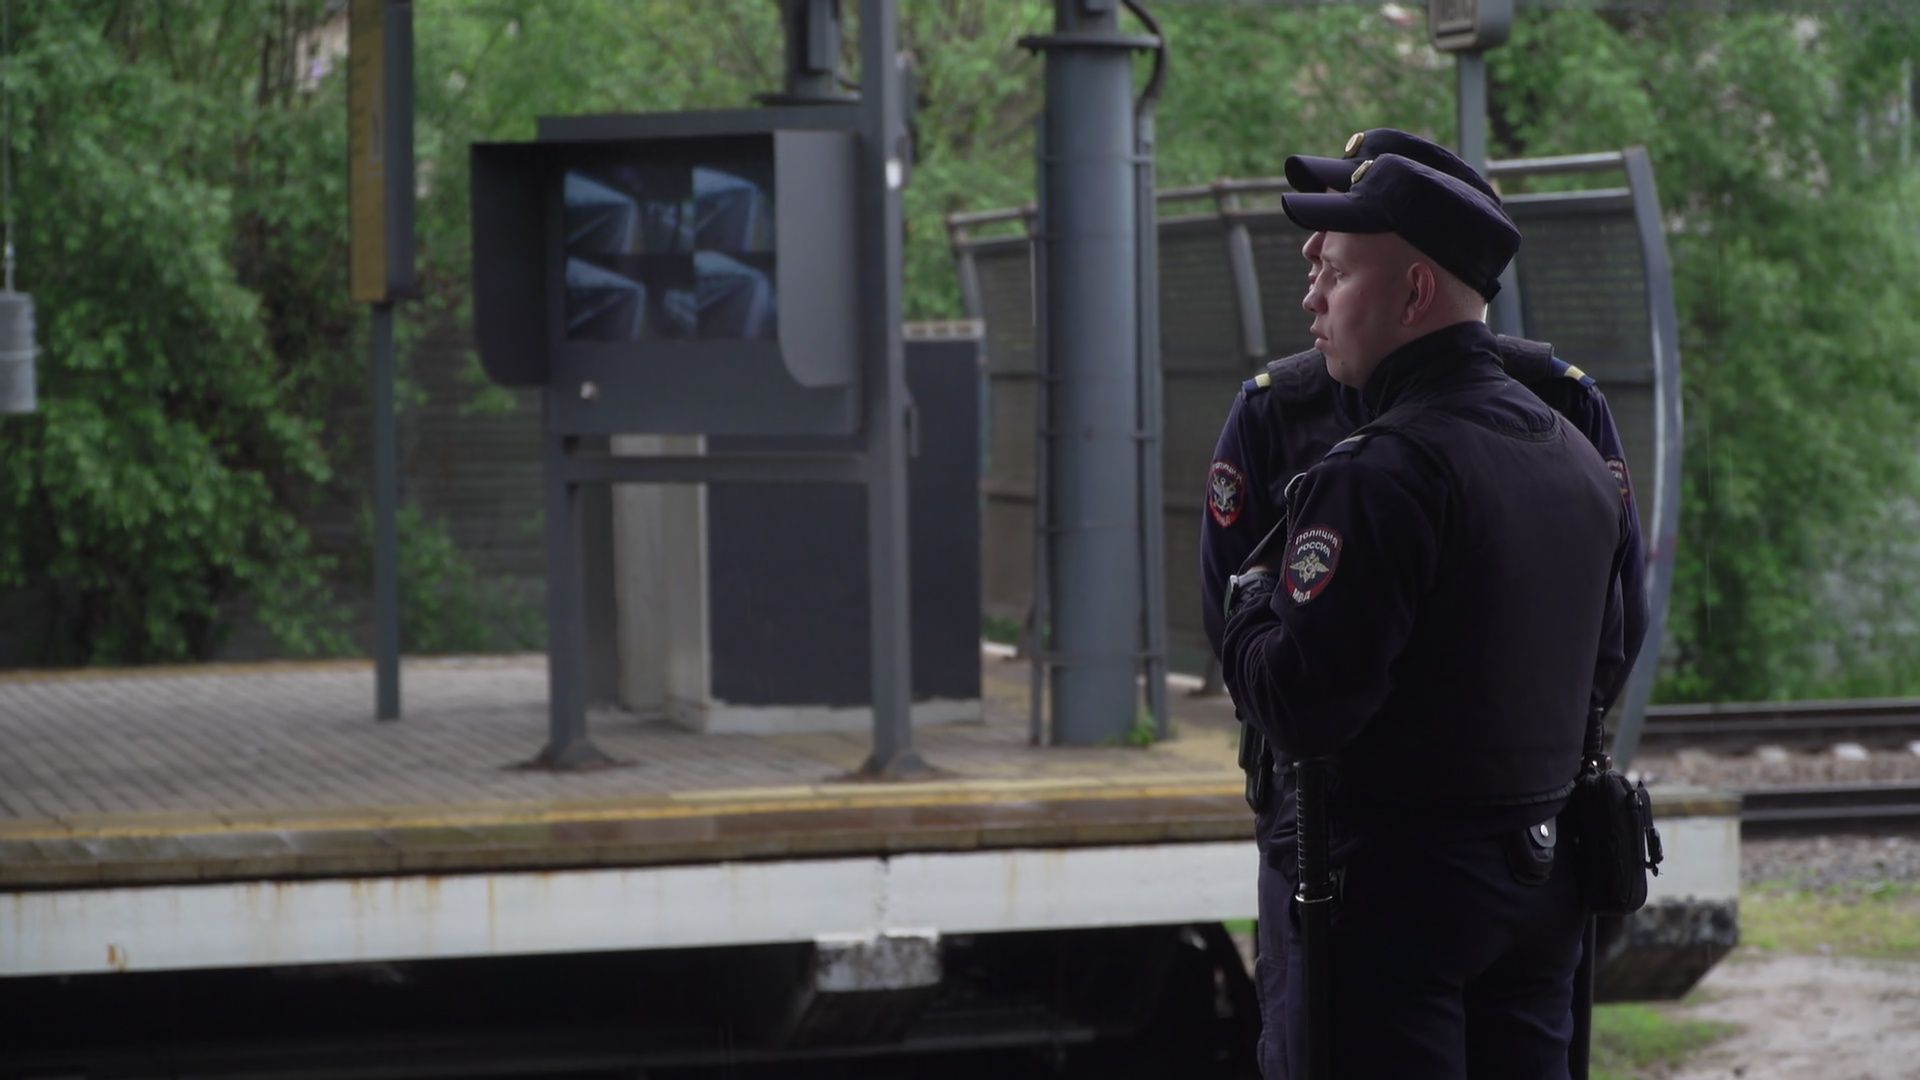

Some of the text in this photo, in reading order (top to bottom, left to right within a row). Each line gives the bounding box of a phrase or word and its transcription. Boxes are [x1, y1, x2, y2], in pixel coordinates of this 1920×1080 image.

[1295, 529, 1338, 548] ПОЛИЦИЯ
[1297, 541, 1331, 558] РОССИЯ
[1292, 588, 1311, 603] МВД
